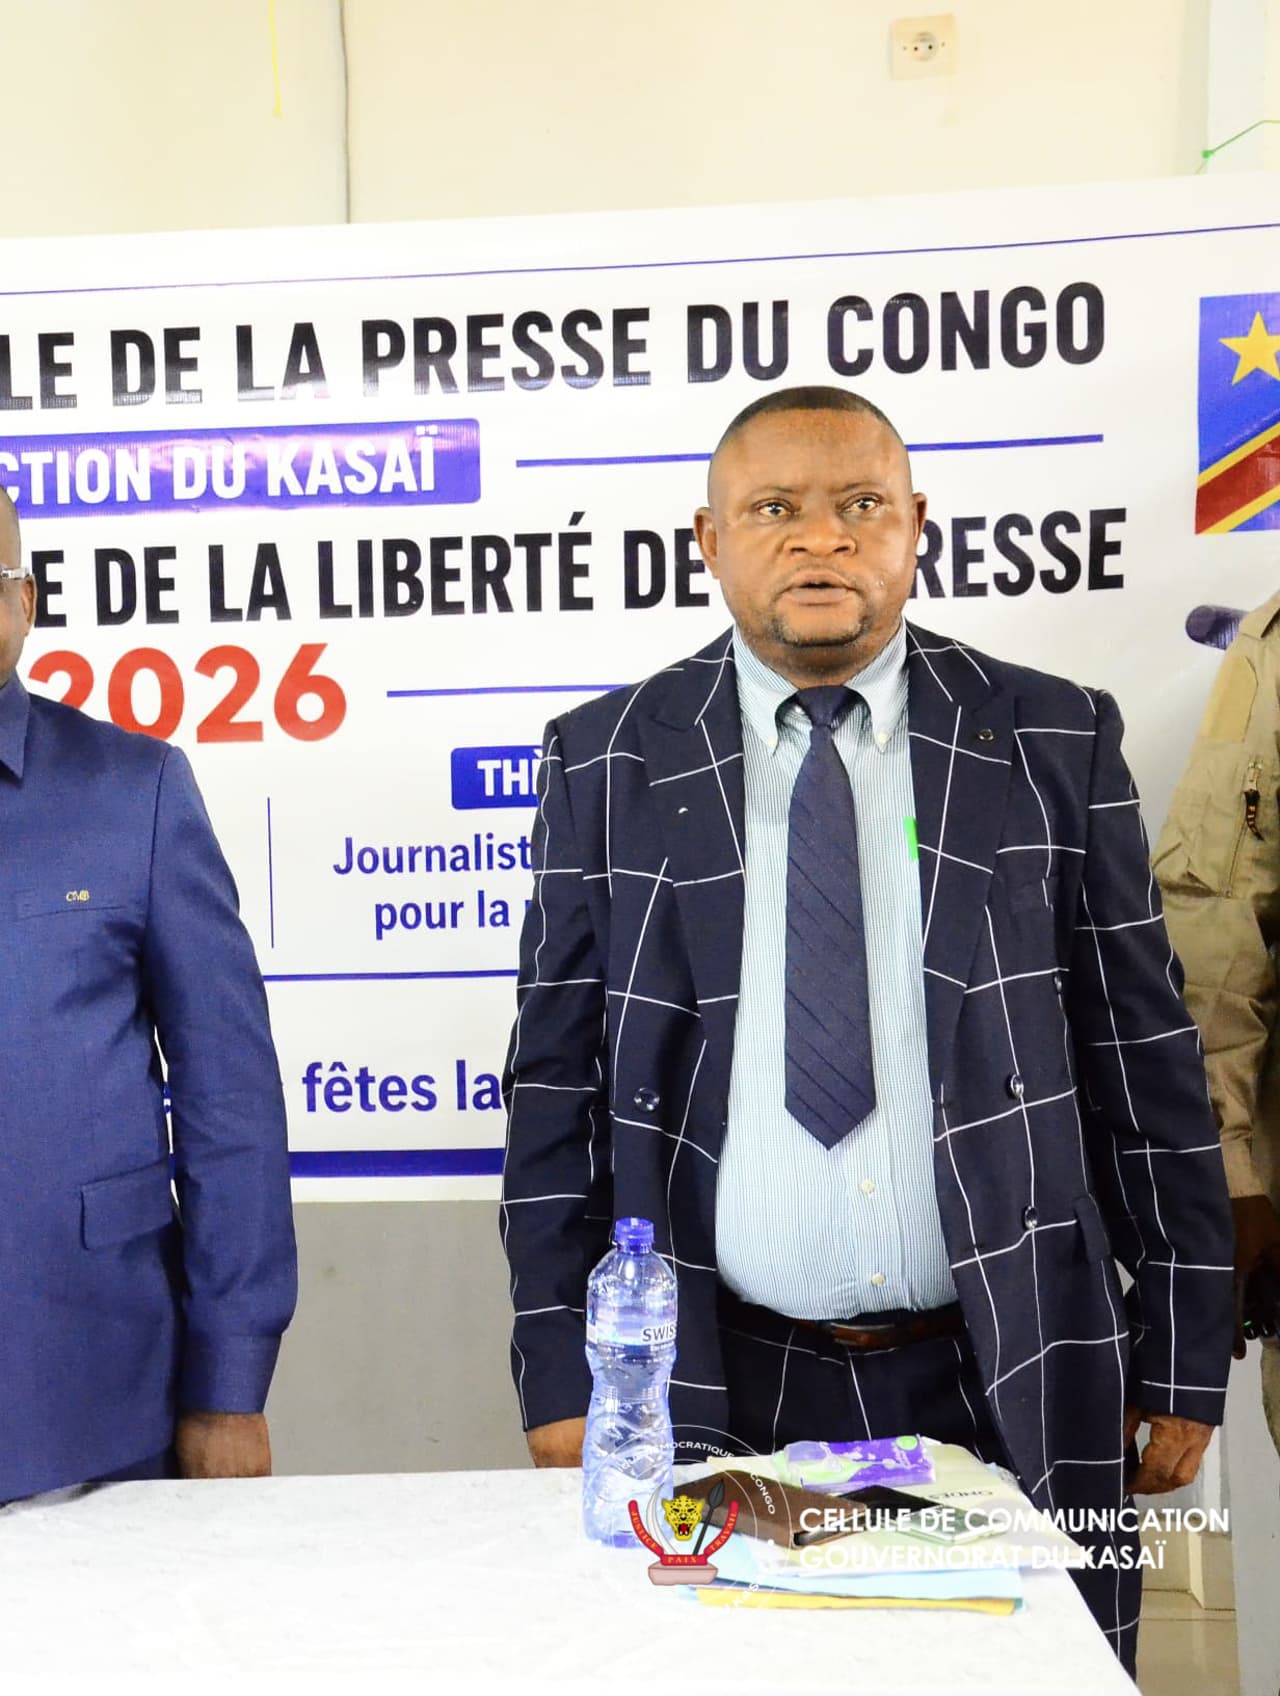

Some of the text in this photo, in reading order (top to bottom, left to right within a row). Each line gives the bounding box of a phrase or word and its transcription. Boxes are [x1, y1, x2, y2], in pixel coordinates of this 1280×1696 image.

[110, 327, 203, 407] DE
[235, 322, 331, 402] LA
[361, 307, 651, 397] PRESSE
[687, 300, 790, 383] DU
[827, 281, 1106, 377] CONGO
[173, 441, 248, 500] DU
[266, 425, 437, 497] KASAÏ
[94, 546, 180, 626] DE
[208, 542, 292, 622] LA
[317, 511, 595, 619] LIBERTÉ
[623, 528, 711, 609] DE
[908, 507, 1127, 600] RESSE
[27, 642, 348, 744] 2026
[333, 832, 533, 876] Journalist
[375, 890, 510, 940] pour la
[302, 1059, 502, 1113] fêtes la
